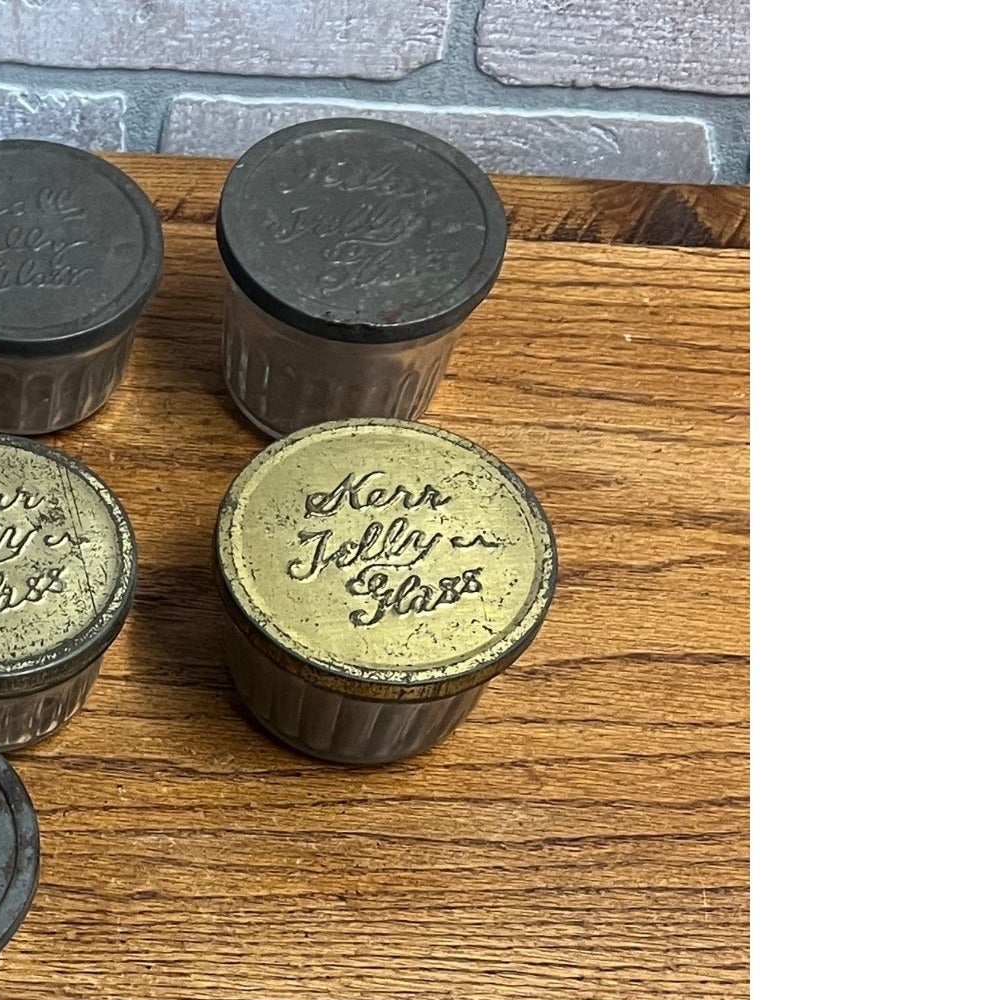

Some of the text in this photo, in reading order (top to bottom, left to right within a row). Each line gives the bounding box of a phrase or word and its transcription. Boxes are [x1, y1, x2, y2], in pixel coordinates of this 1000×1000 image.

[304, 471, 451, 518] Kerr
[288, 517, 443, 583] Jelly
[345, 566, 484, 629] Glass
